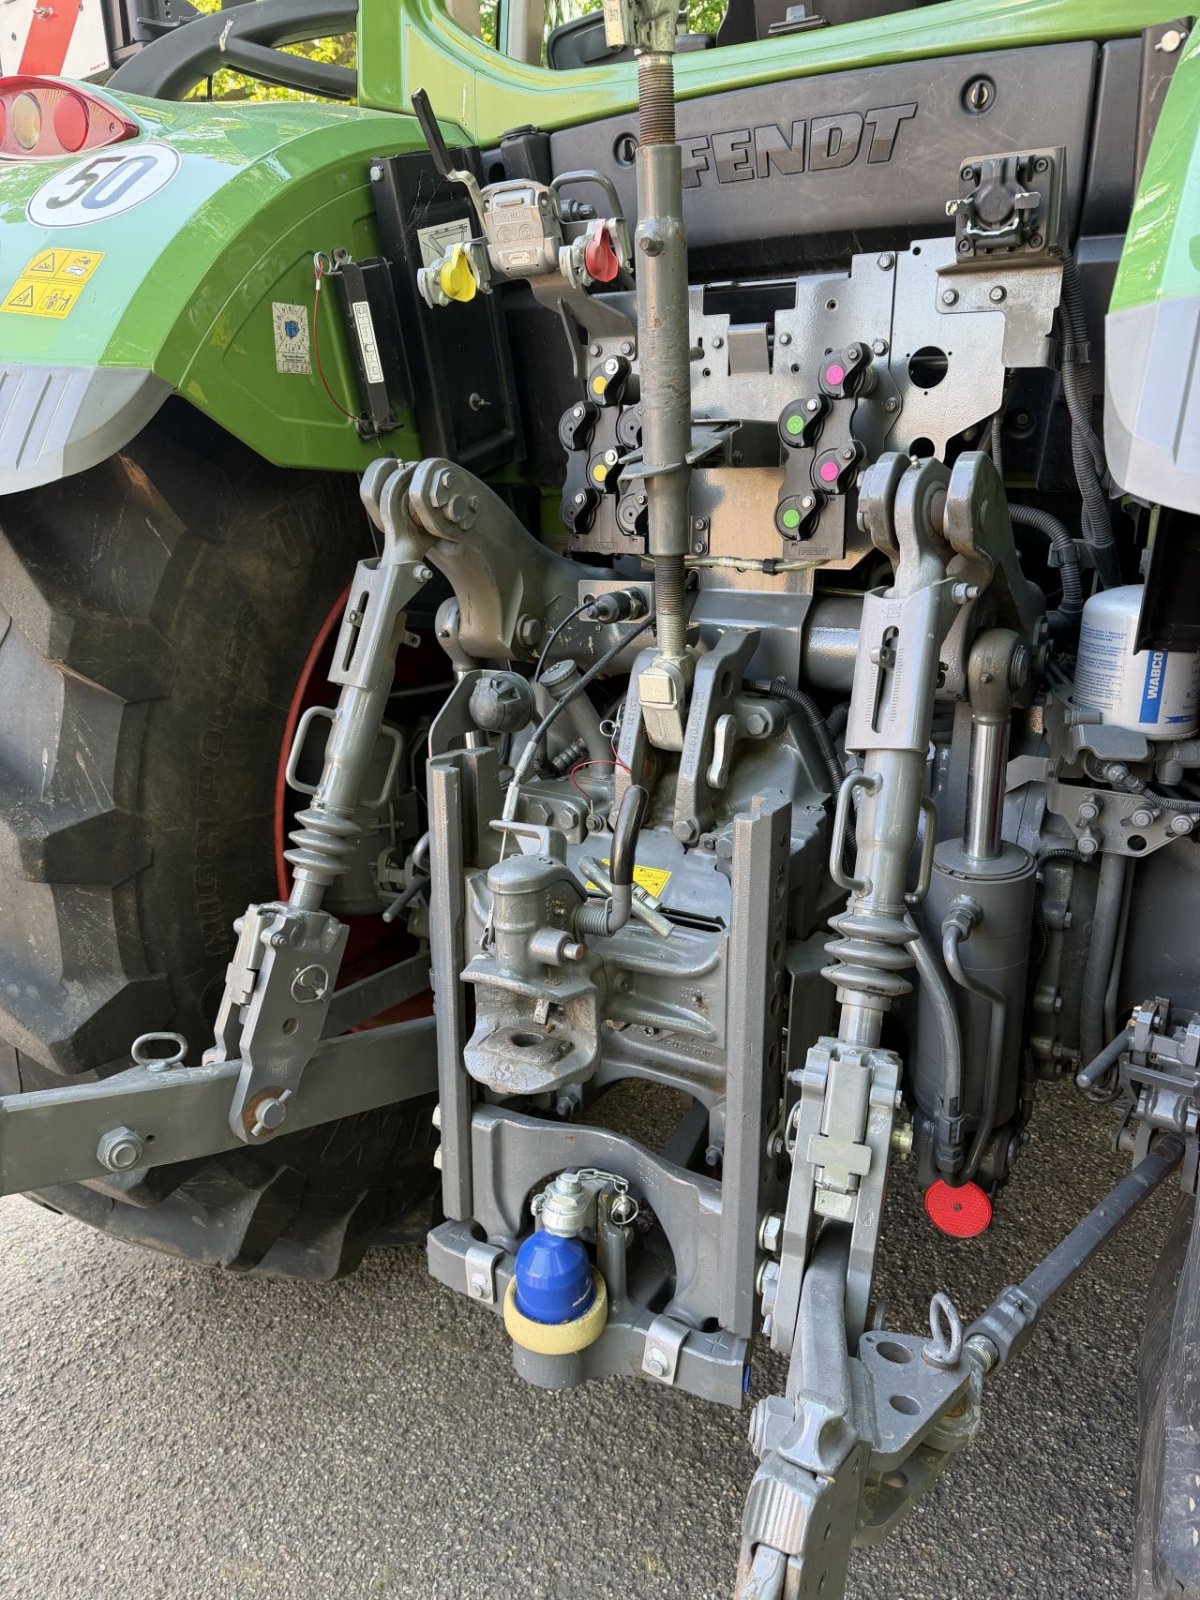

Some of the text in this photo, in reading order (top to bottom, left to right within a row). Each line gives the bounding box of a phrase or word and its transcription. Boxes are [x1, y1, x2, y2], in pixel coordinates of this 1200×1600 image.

[675, 102, 918, 188] FENDT
[45, 155, 158, 210] 50
[1147, 652, 1164, 700] WABCO
